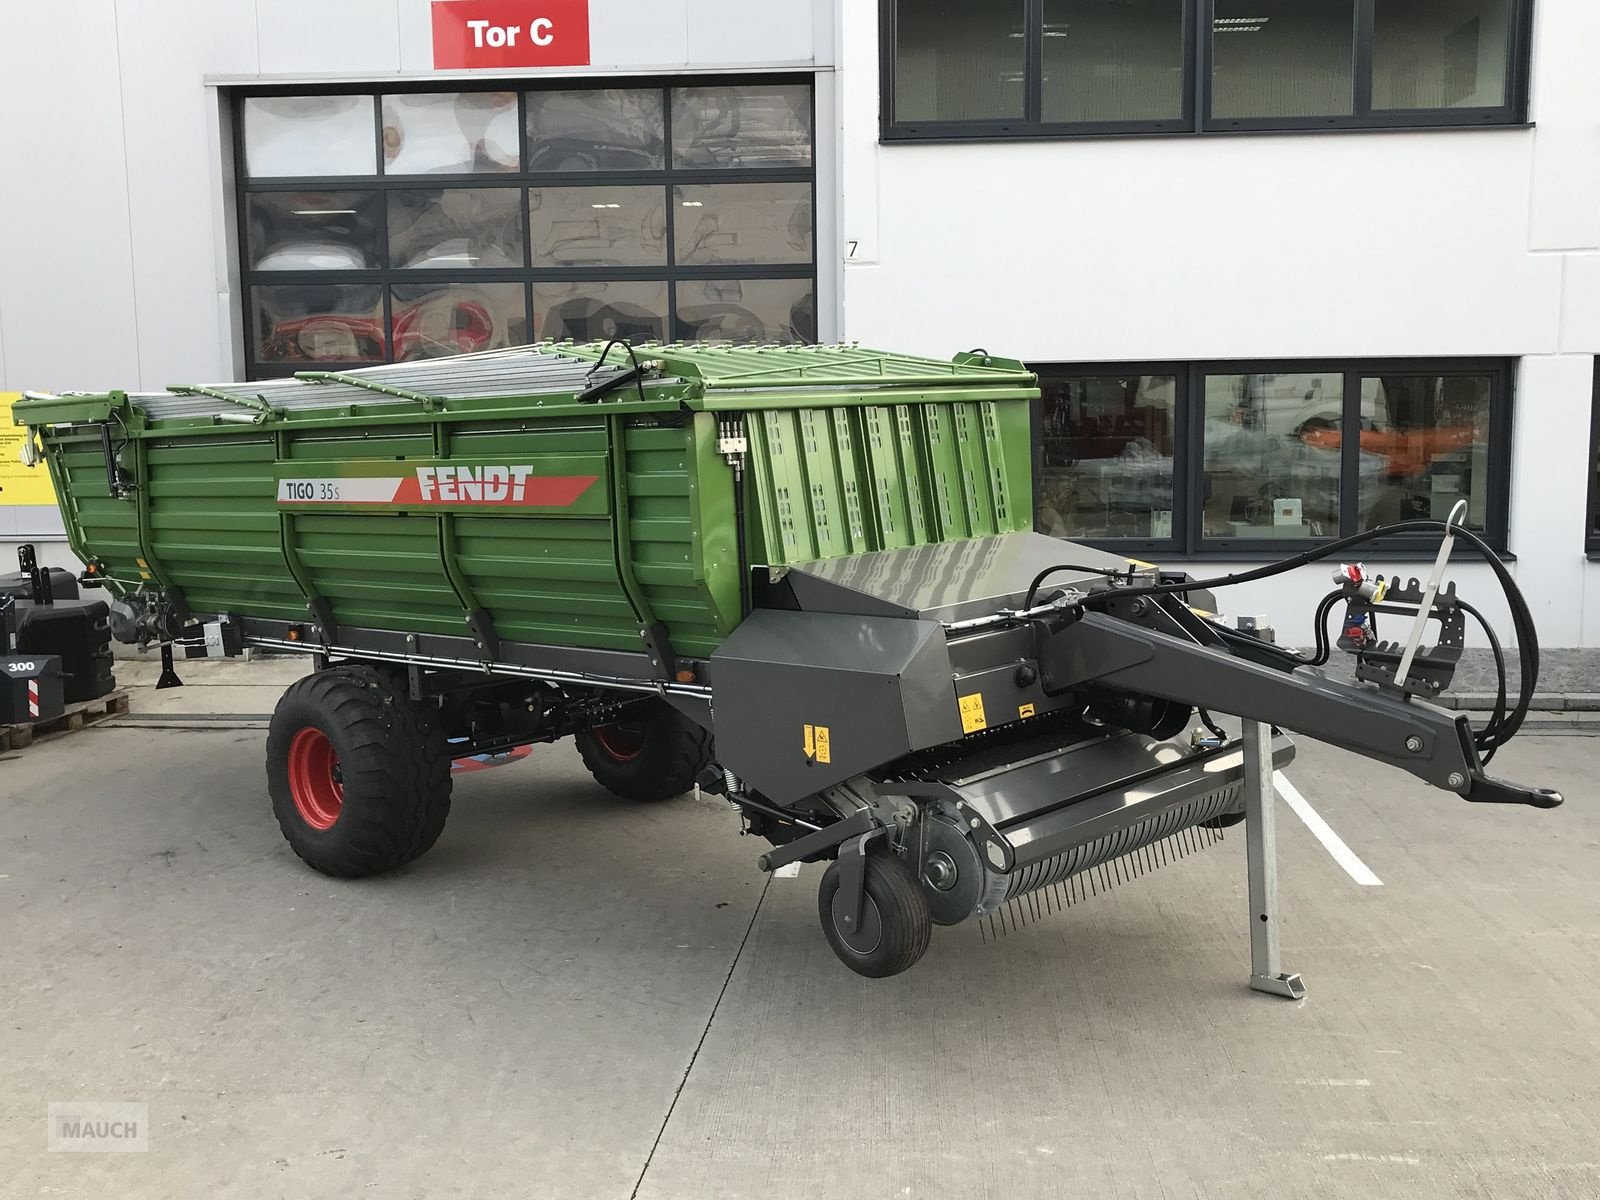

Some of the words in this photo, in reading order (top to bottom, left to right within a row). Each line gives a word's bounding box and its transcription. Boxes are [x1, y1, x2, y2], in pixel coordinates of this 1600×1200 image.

[467, 20, 520, 47] Tor
[530, 18, 553, 46] C
[848, 241, 858, 257] 7
[286, 482, 314, 500] TIGO
[416, 465, 534, 501] FENDT
[8, 661, 35, 673] 300
